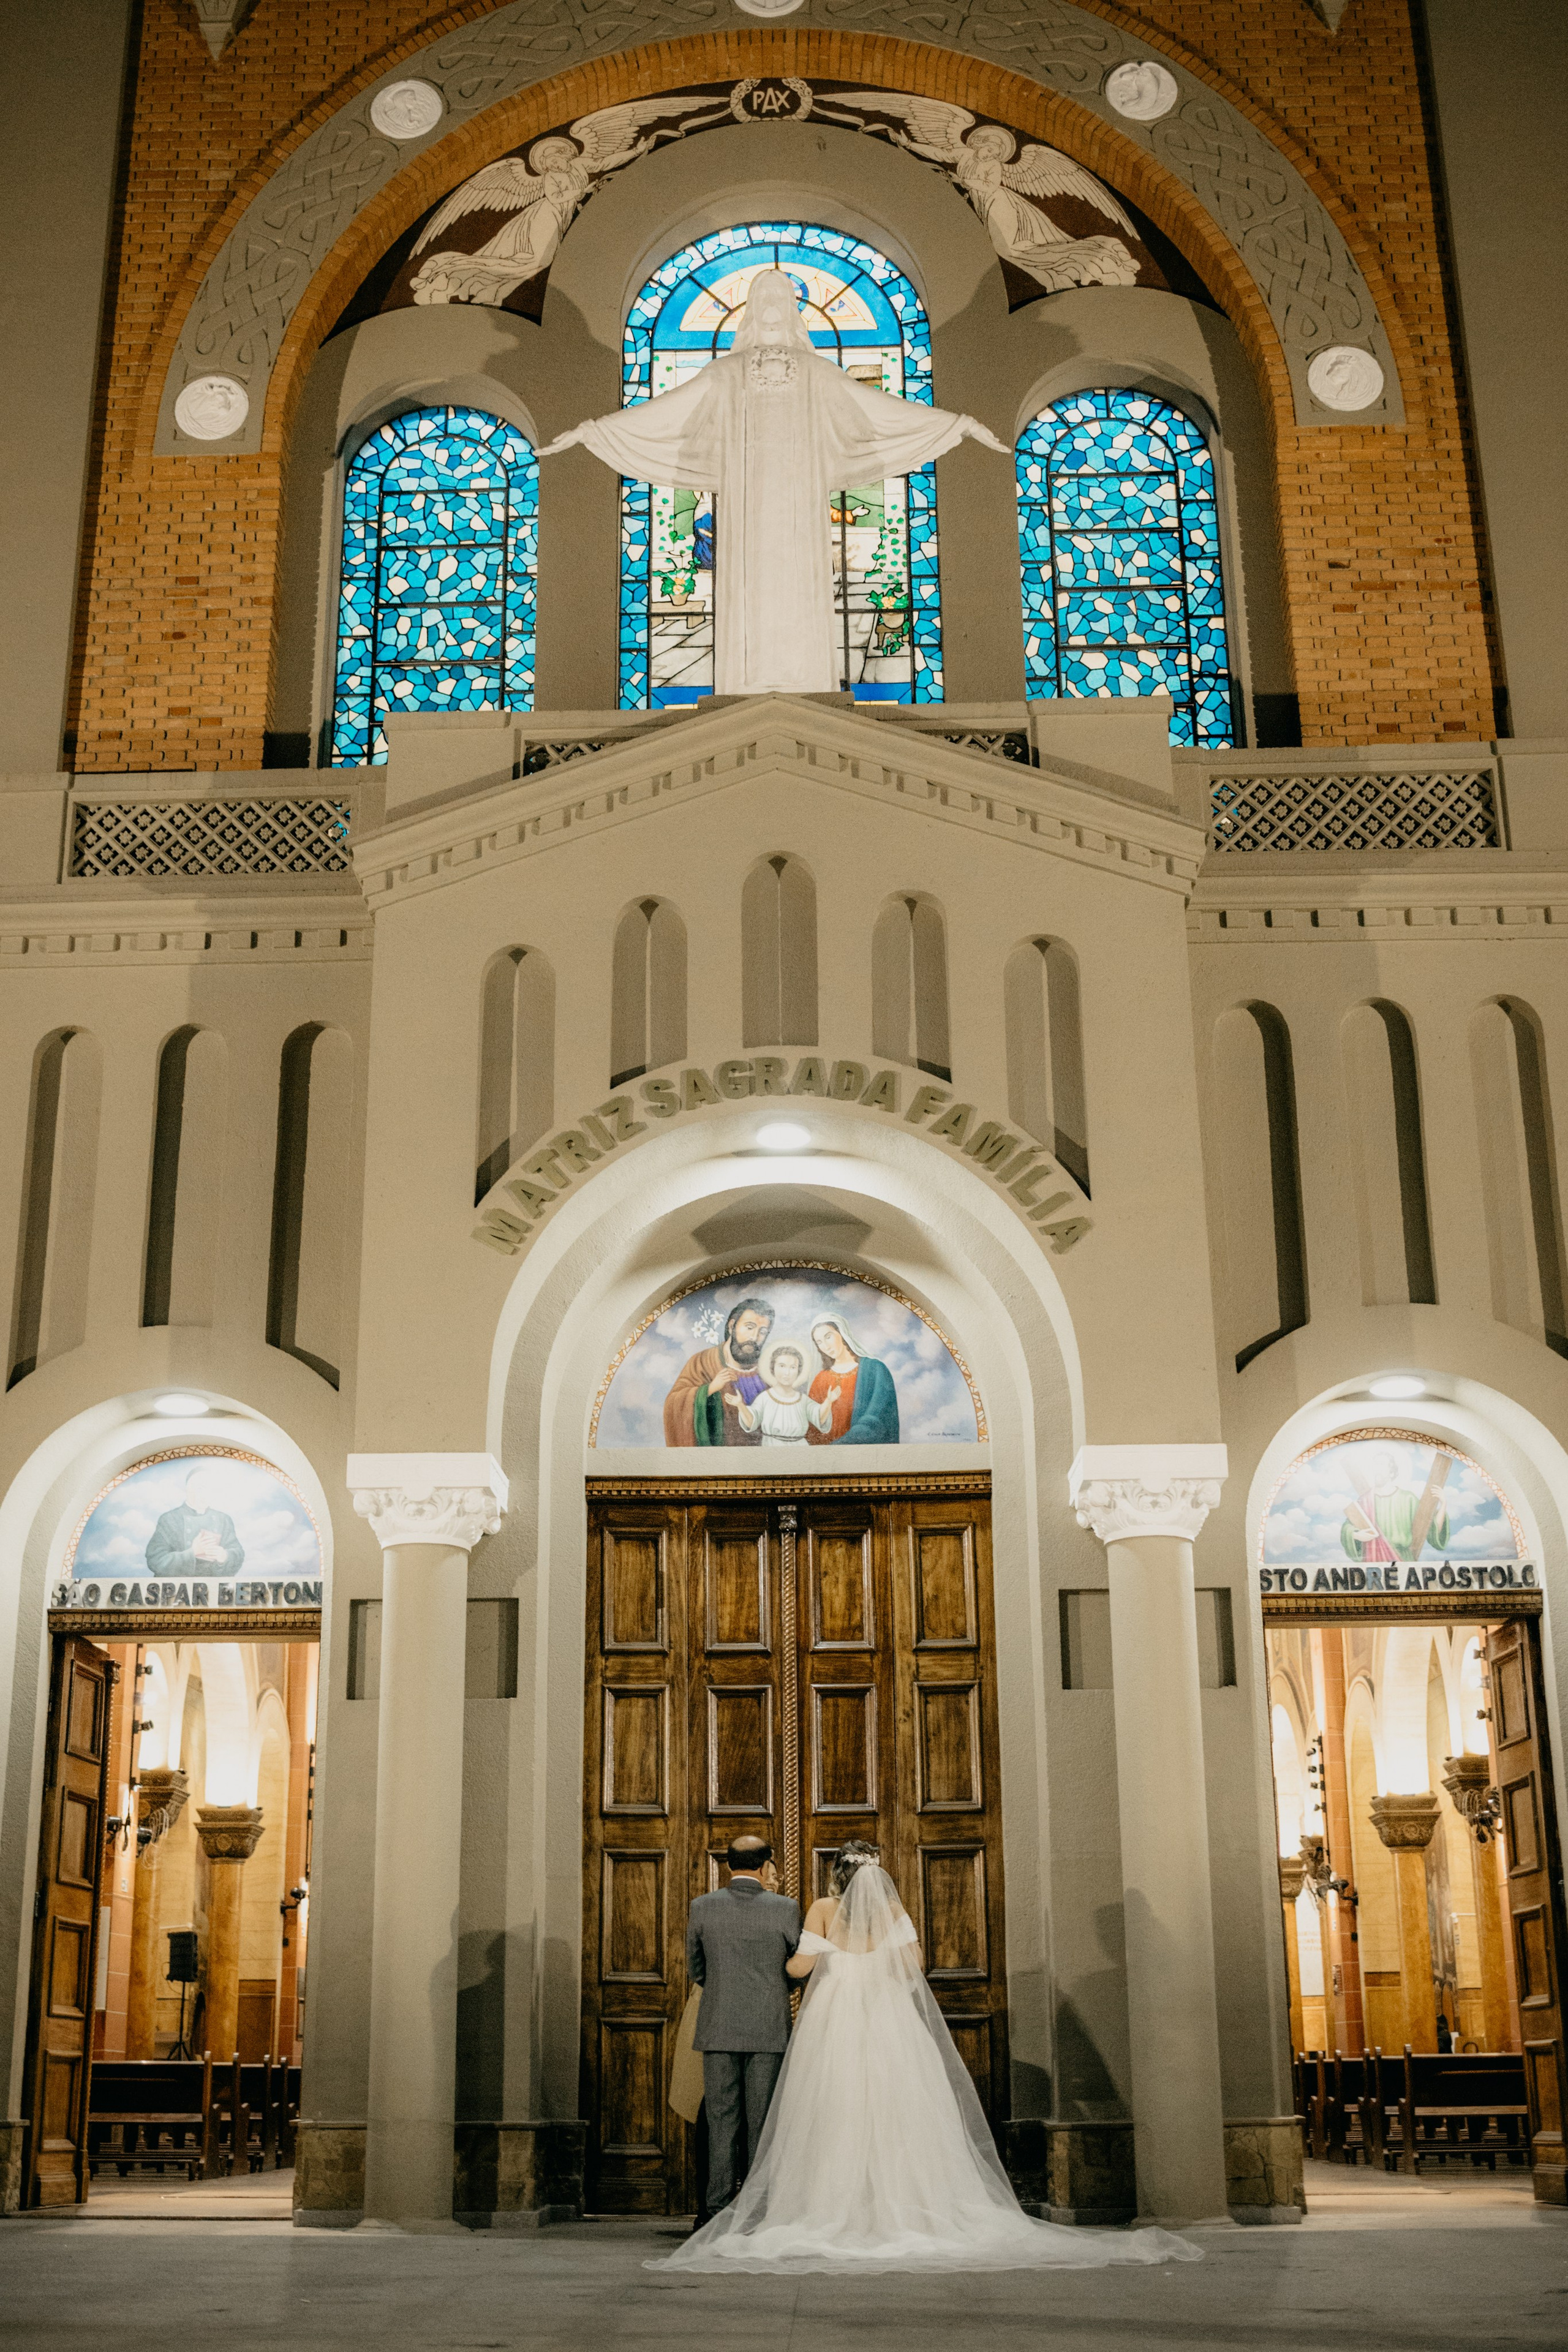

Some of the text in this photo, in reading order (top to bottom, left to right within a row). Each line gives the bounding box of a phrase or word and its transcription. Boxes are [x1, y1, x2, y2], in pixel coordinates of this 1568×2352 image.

[753, 87, 791, 113] PAX
[470, 1057, 1093, 1256] MATRIZ SAGRADA FAMÍLIA
[1259, 1560, 1536, 1591] STO ANDRÉ APÓSTOLO
[110, 1582, 209, 1607] GASPAR
